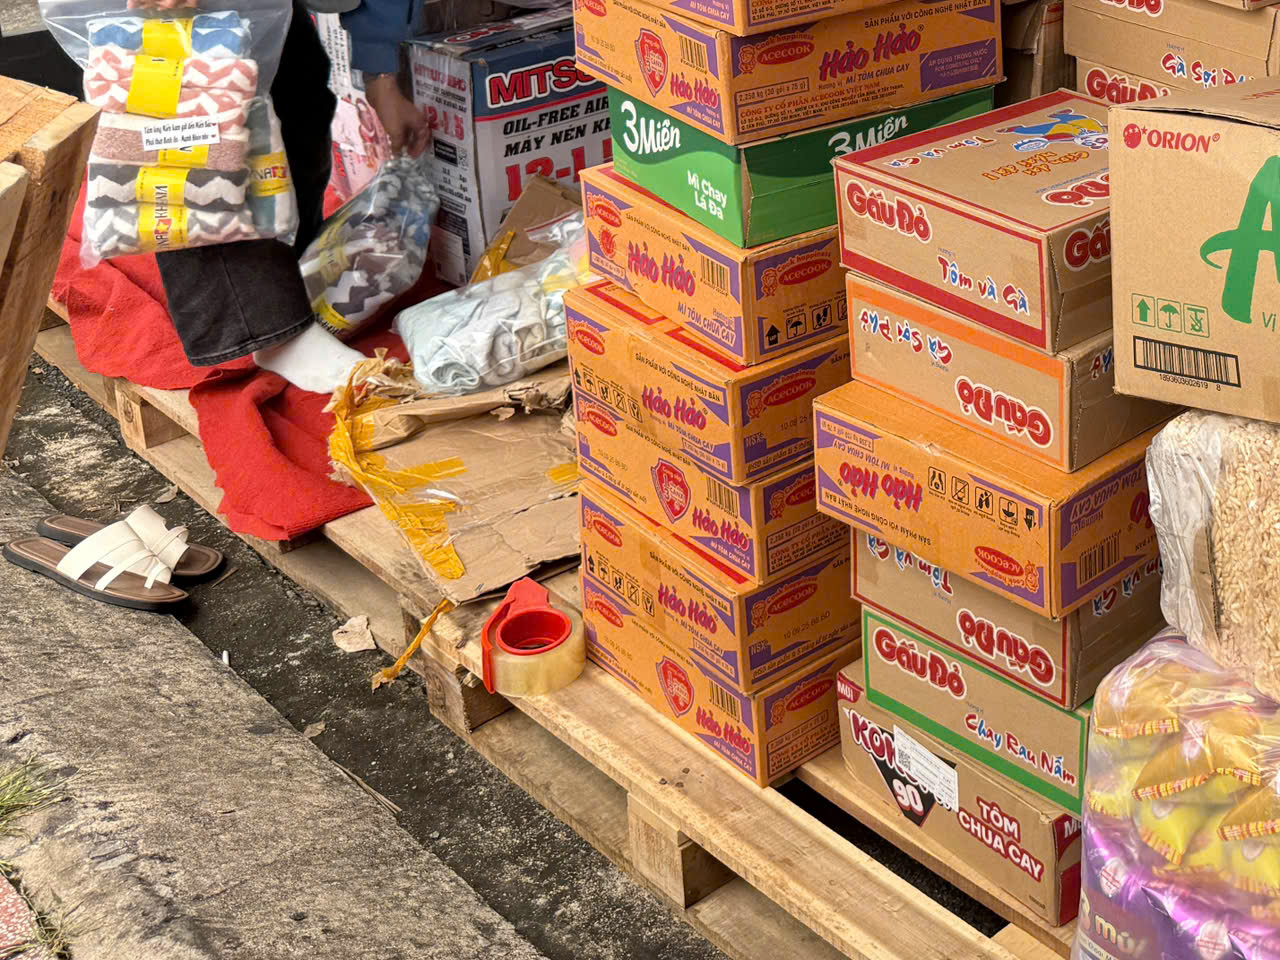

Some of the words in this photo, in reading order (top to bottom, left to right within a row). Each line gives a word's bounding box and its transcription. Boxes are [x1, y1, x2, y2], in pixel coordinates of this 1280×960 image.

[913, 8, 934, 20] CÔNG
[819, 40, 869, 81] Hảo
[873, 23, 921, 62] Hảo
[1146, 129, 1211, 154] ORION
[701, 177, 728, 206] Chay
[628, 240, 660, 284] Hảo
[661, 252, 696, 297] Hảo
[937, 255, 973, 290] Tôm
[977, 276, 998, 303] và
[1002, 283, 1030, 316] Gà
[1261, 311, 1277, 333] Vị
[642, 384, 672, 419] Hảo
[674, 396, 707, 431] Hảo
[964, 713, 1002, 750] Chay
[1005, 731, 1037, 769] Rau
[1040, 747, 1076, 786] Nấm
[893, 778, 924, 815] 90
[979, 800, 1020, 840] TÔM
[959, 810, 1006, 856] CHUA
[1008, 843, 1043, 880] CAY
